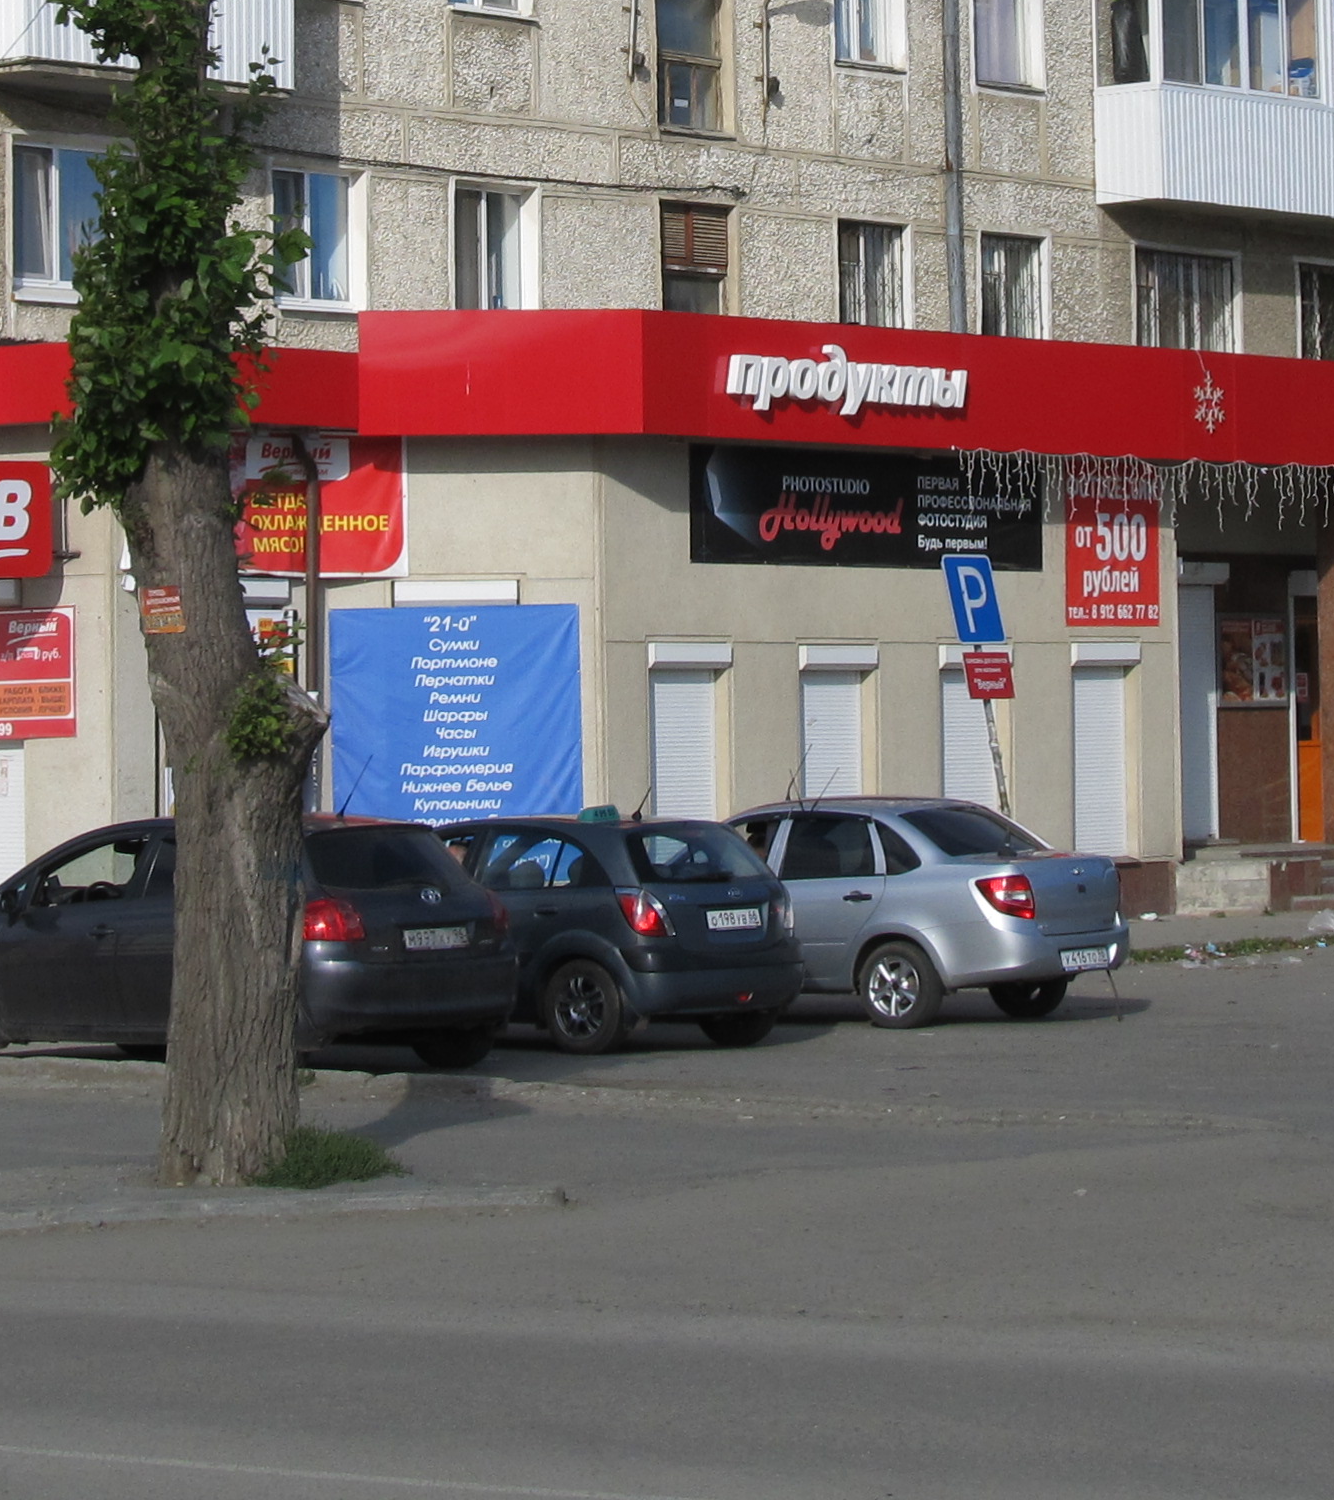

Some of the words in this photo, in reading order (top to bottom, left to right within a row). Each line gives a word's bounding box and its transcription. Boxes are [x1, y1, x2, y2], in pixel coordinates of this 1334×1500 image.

[726, 344, 968, 416] продукты
[261, 442, 334, 459] Верй
[782, 475, 871, 494] PHOTOSTUDIO
[917, 476, 960, 491] ПЕРВАЯ
[251, 514, 389, 535] ОХЛАЖЕННОЕ
[759, 491, 905, 550] Hollywood
[917, 513, 988, 531] ФОТОСТУДИЯ
[917, 534, 943, 551] Будь
[945, 537, 988, 552] первым!
[1075, 526, 1093, 548] от
[1096, 512, 1147, 561] 500
[253, 536, 304, 553] МЯСО!
[1083, 566, 1140, 598] рублей
[1091, 604, 1098, 619] 8
[1100, 604, 1115, 619] 912
[8, 617, 58, 636] Верный
[428, 638, 480, 653] Сумки
[410, 656, 498, 671] Портмоне
[414, 674, 496, 689] Перчатки
[429, 691, 482, 705] Ремни
[423, 709, 488, 723] Шарфы
[435, 727, 478, 740] Часы
[422, 745, 490, 760] Игрушки
[400, 763, 514, 778] Парфюмерия
[401, 781, 462, 794] Нижнее
[413, 798, 502, 813] Купальники
